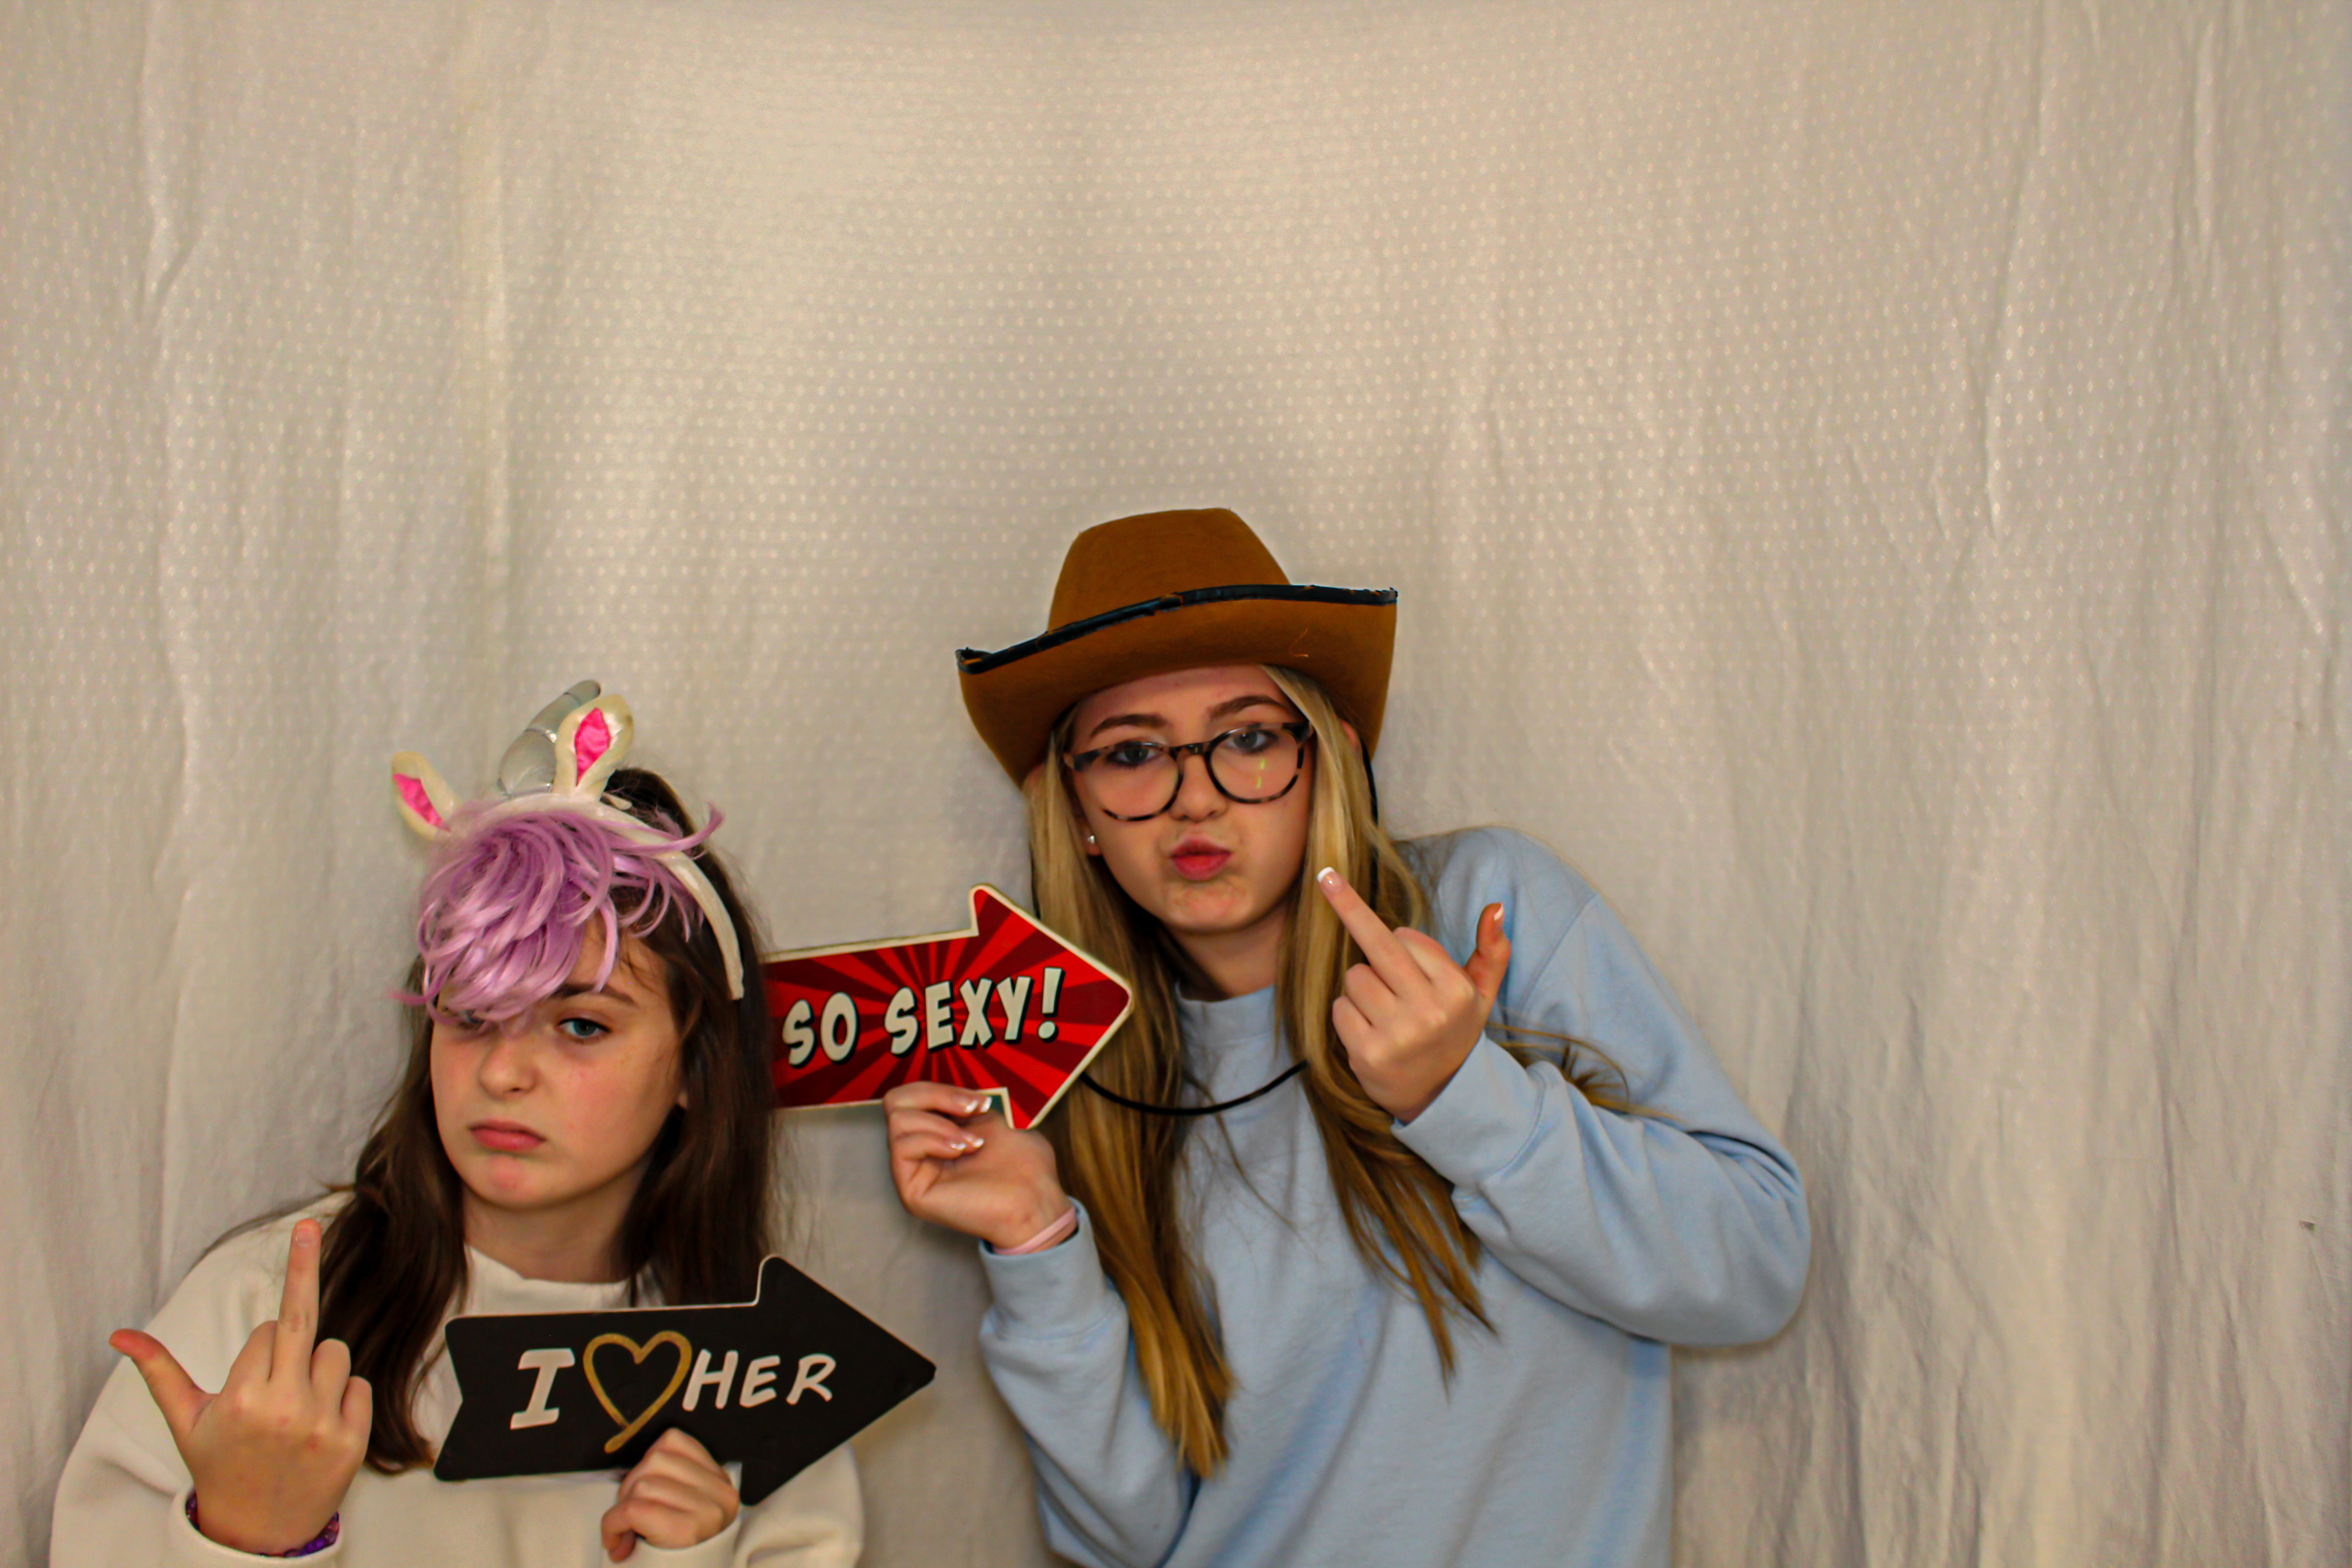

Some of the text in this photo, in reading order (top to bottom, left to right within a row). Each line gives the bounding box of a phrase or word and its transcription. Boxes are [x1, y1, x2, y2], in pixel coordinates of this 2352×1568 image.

[782, 966, 1065, 1068] SO SEXY!
[510, 1348, 837, 1430] I HER
